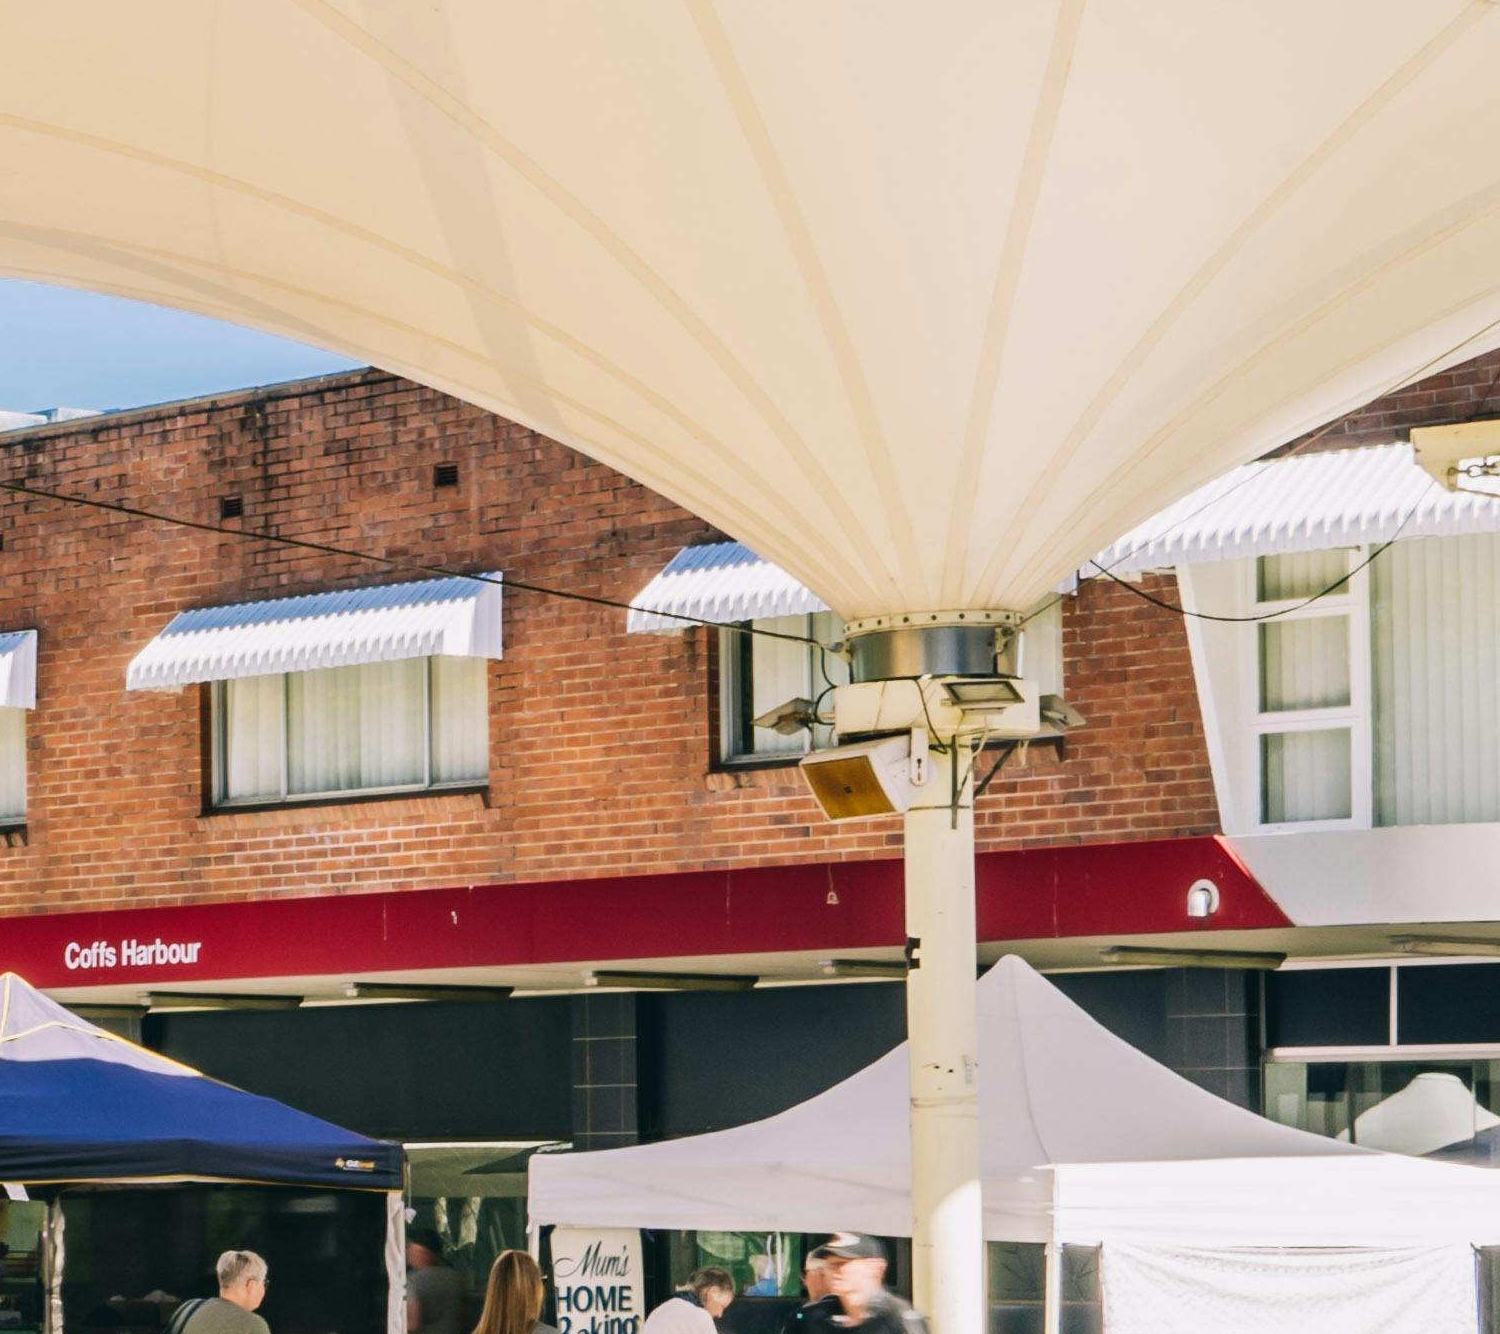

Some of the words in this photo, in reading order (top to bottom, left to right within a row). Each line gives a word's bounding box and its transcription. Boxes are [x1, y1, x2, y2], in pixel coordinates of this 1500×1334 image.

[65, 941, 117, 970] Coffs
[121, 938, 201, 966] Harbour
[554, 1241, 630, 1278] Mum's
[556, 1285, 633, 1313] HOME
